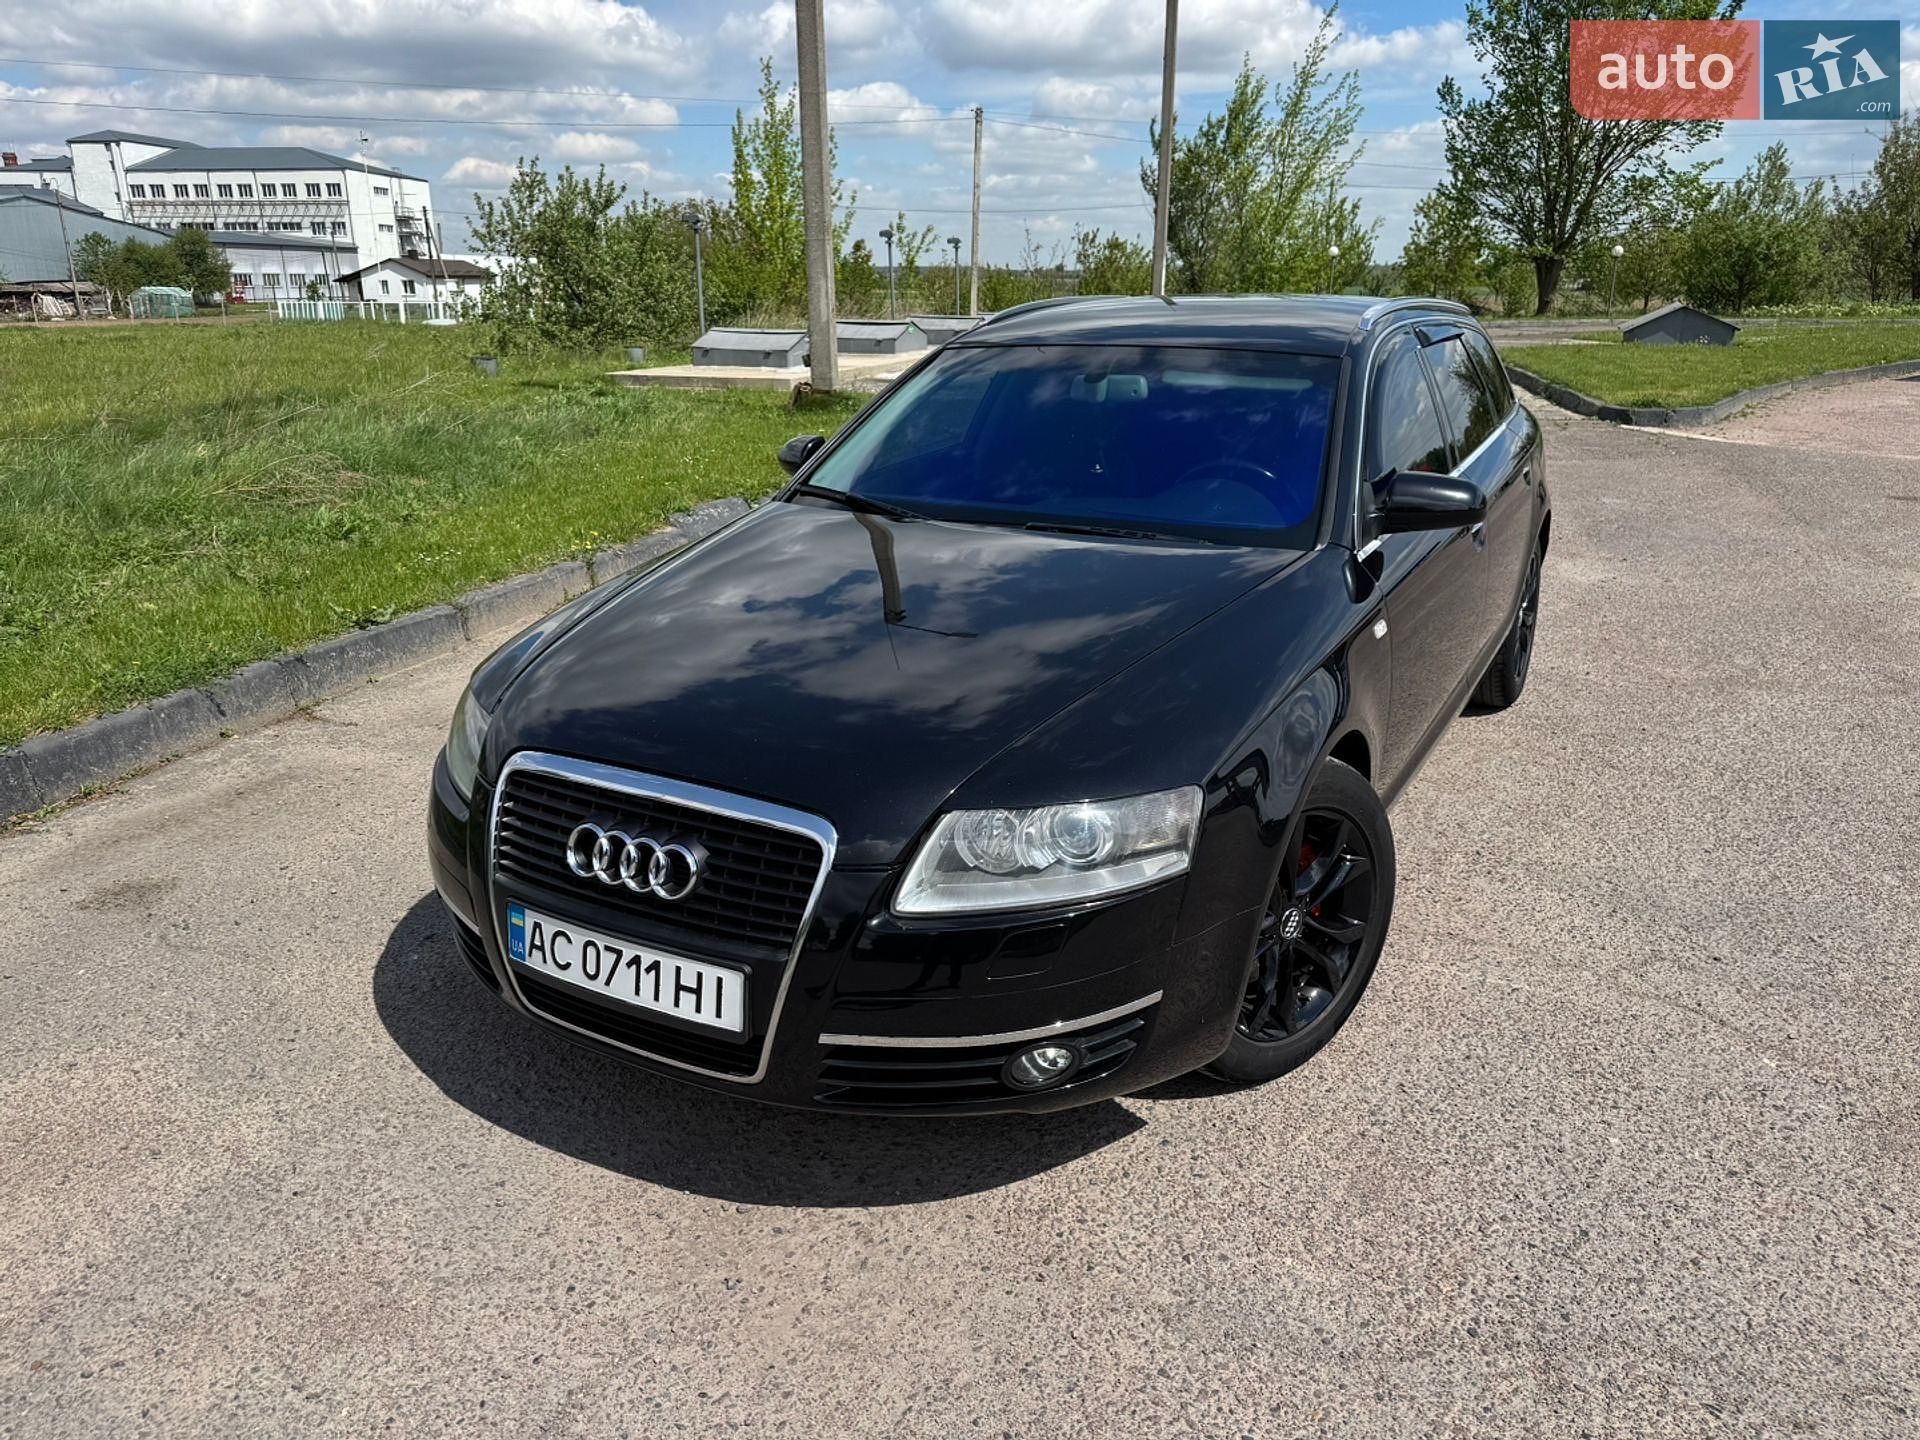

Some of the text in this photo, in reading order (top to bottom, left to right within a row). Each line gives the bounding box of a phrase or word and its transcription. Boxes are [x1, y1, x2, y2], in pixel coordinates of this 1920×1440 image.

[511, 939, 524, 954] UA
[528, 919, 723, 1020] AC 0711 HI
